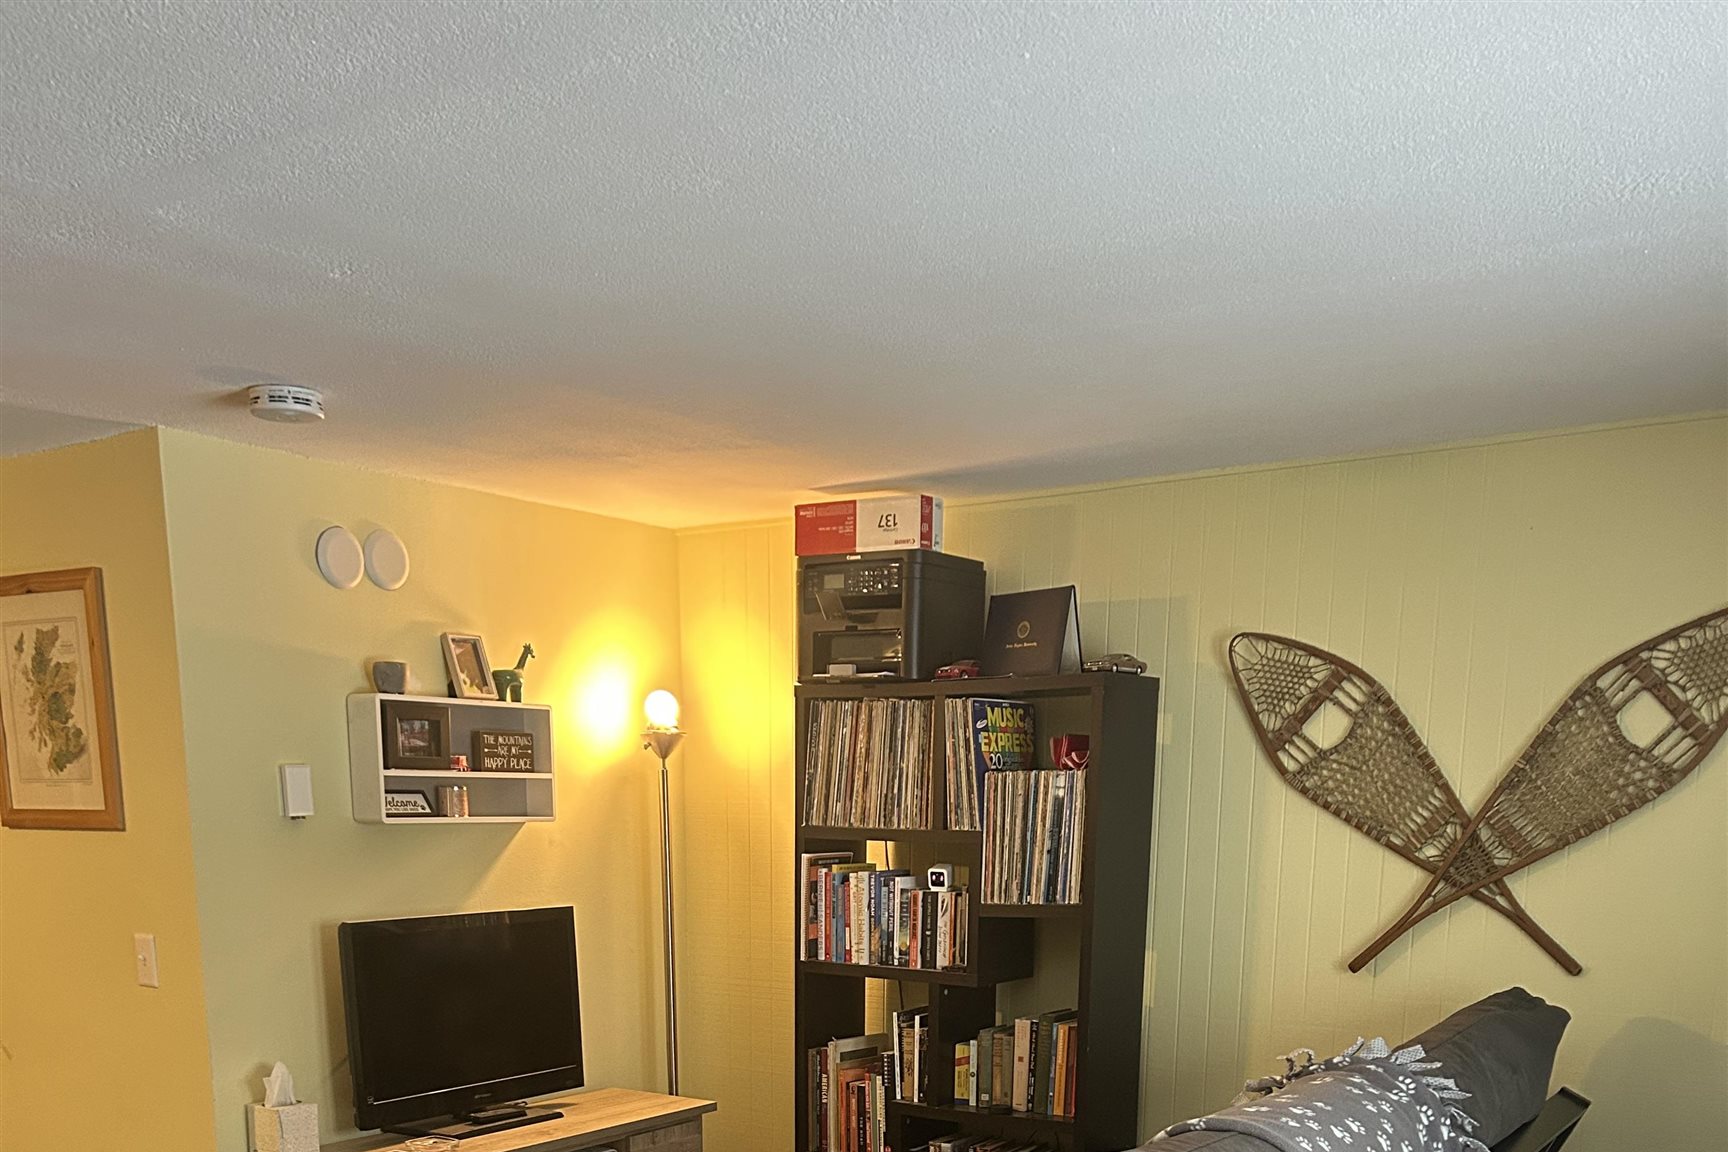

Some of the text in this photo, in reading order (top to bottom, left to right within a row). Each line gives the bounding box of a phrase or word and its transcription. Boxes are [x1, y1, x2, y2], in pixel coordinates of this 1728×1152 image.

[878, 513, 898, 529] 137
[894, 538, 916, 546] Canon
[986, 706, 1025, 728] MUSIC
[483, 734, 533, 746] THE MOUNTAINS
[981, 731, 1034, 753] EXPRESS
[497, 745, 520, 757] ARE MY
[484, 757, 533, 770] HAPPY PLACE
[989, 753, 1003, 769] 20
[385, 796, 420, 808] elcome
[857, 886, 867, 946] Atomic Habits
